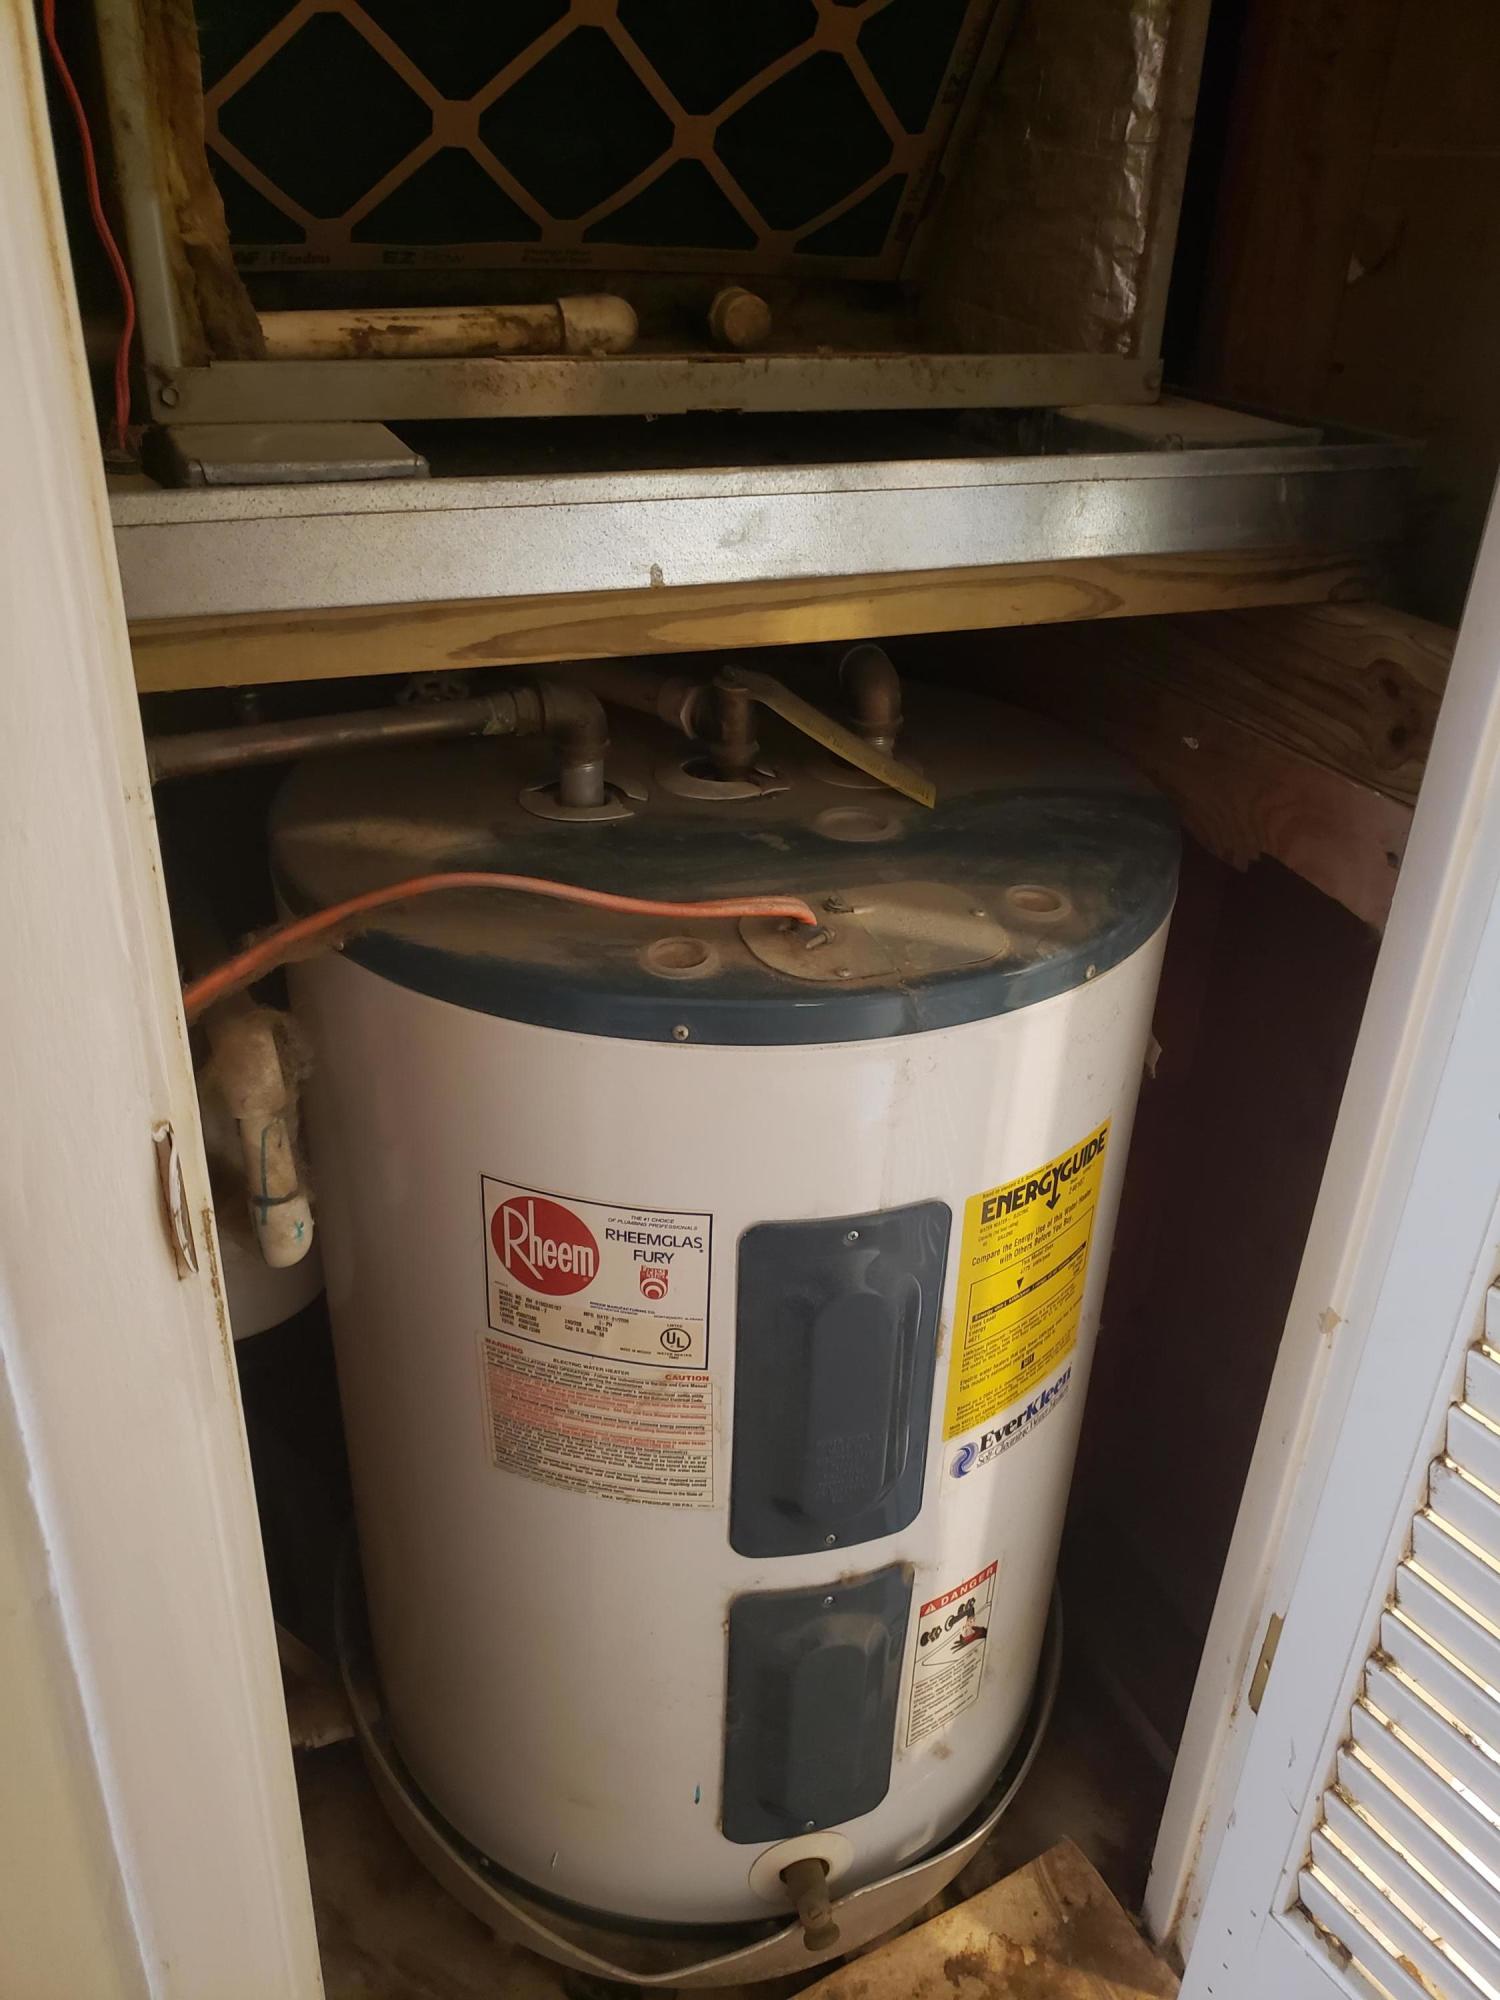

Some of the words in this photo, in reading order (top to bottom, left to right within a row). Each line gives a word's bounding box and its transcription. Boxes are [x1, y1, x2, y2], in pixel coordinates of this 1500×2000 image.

[981, 1127, 1108, 1225] ENERGYGUIDE
[617, 1219, 647, 1227] PLUMBING
[648, 1223, 698, 1231] PROFESSIONALS
[503, 1199, 595, 1281] Rheem
[971, 1248, 1001, 1267] Compare
[1002, 1241, 1013, 1253] the
[1014, 1231, 1035, 1248] Energy
[1035, 1224, 1045, 1236] Use
[1046, 1219, 1053, 1229] of
[1052, 1212, 1064, 1225] this
[999, 1252, 1013, 1265] with
[1013, 1243, 1033, 1259] Others
[1034, 1230, 1052, 1247] Before
[633, 1249, 675, 1265] FURY
[485, 1338, 525, 1354] WARNING
[666, 1331, 685, 1348] UL
[552, 1358, 582, 1368] ELECTRIC
[583, 1363, 604, 1372] WATER
[604, 1367, 630, 1376] HEATER
[665, 1374, 709, 1382] CAUTION
[979, 1365, 1072, 1453] EverKleen
[940, 1564, 995, 1607] DANGER
